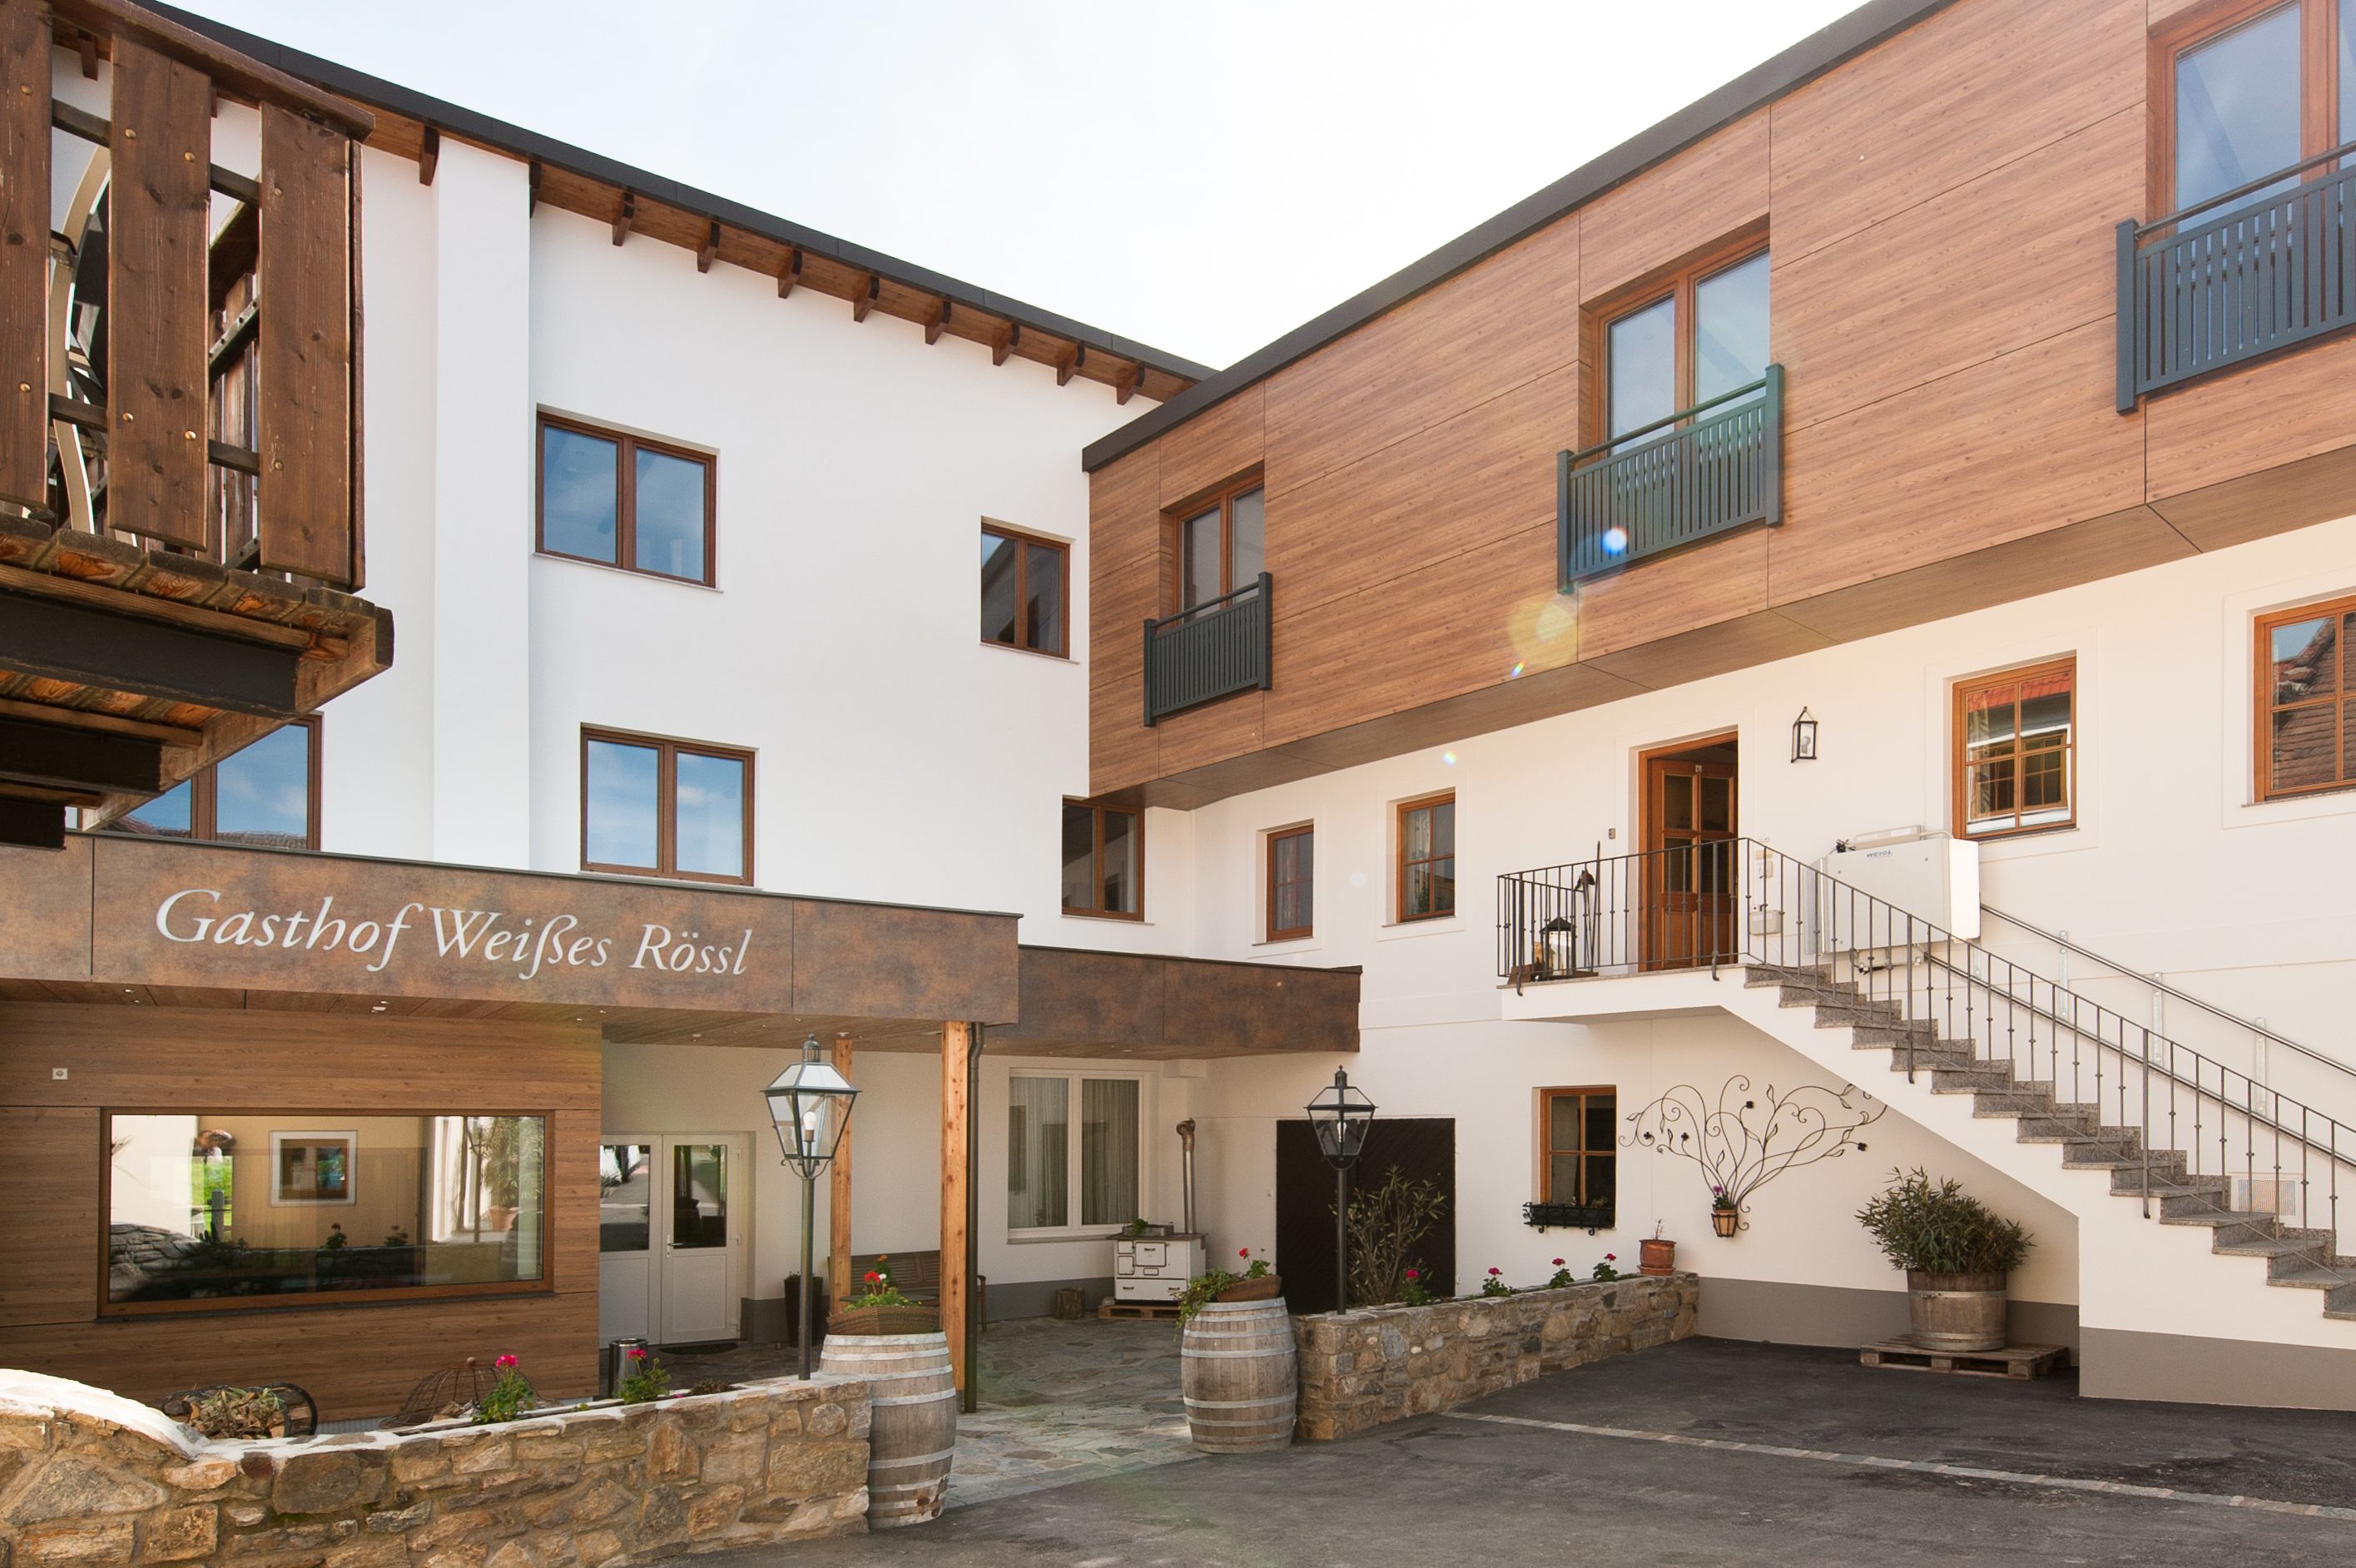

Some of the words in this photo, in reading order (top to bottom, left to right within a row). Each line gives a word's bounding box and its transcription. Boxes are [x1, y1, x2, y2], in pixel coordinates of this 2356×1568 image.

[156, 889, 424, 972] Gasthof
[431, 907, 612, 980] Weißes
[628, 924, 752, 975] Rössl
